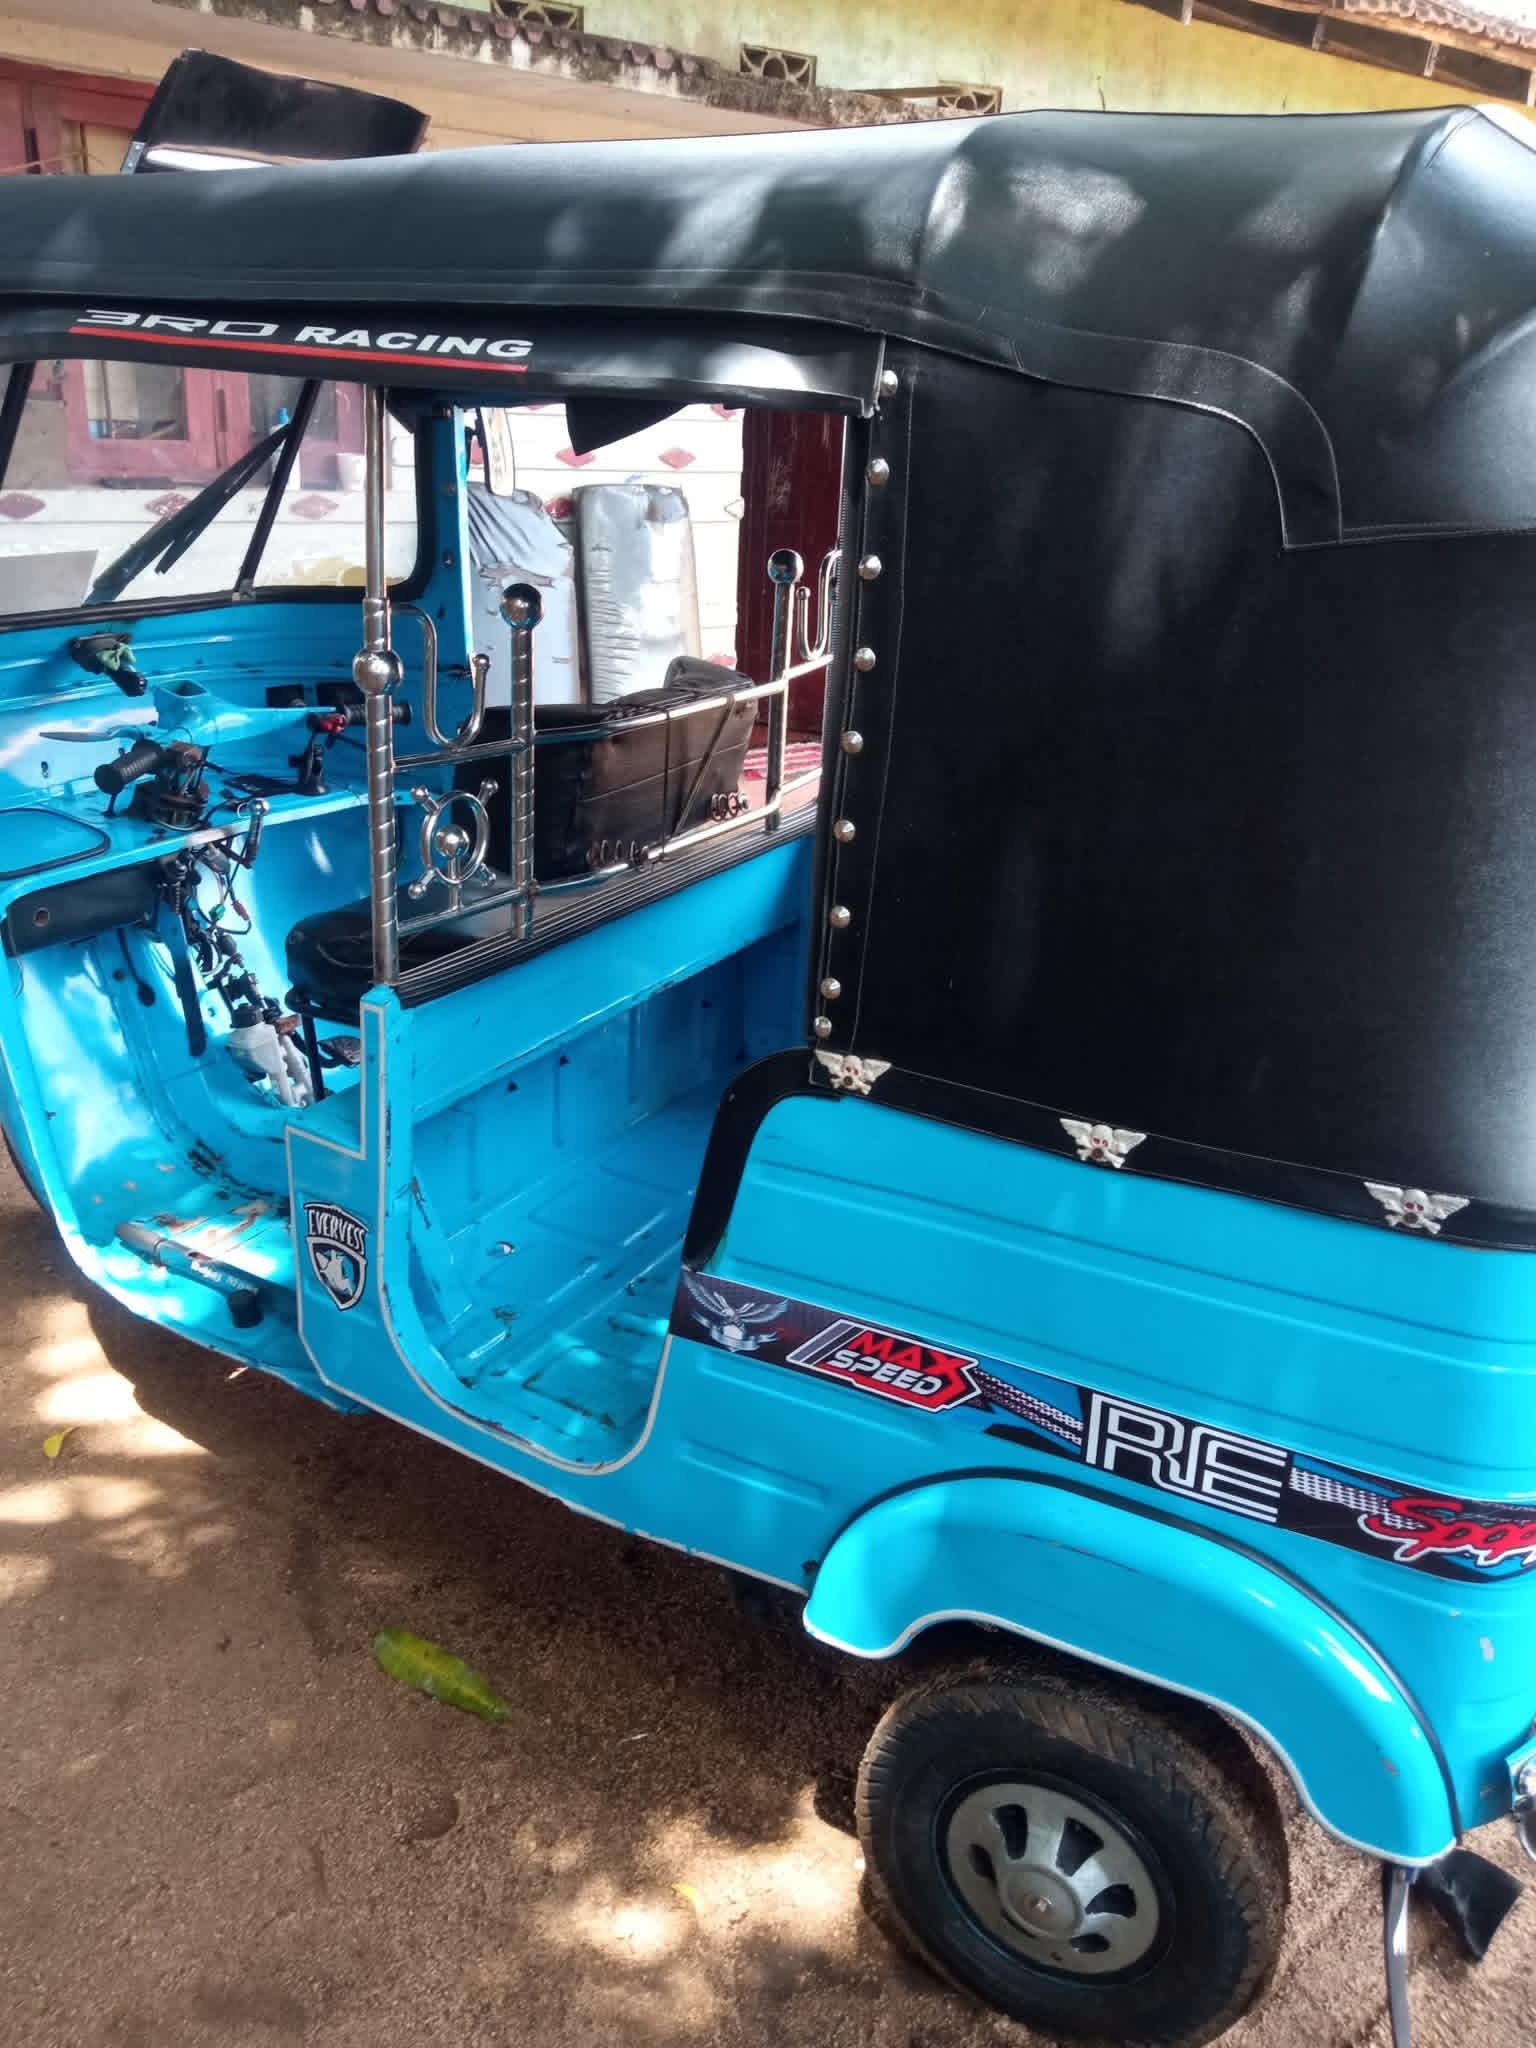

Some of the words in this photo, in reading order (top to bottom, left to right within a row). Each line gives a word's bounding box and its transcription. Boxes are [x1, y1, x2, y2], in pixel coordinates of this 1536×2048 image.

[75, 308, 280, 338] 3RD
[293, 325, 536, 359] RACING
[306, 1208, 367, 1257] EVERVESS
[828, 1349, 944, 1397] SPEED
[847, 1330, 970, 1380] MAX
[1085, 1392, 1289, 1525] RE
